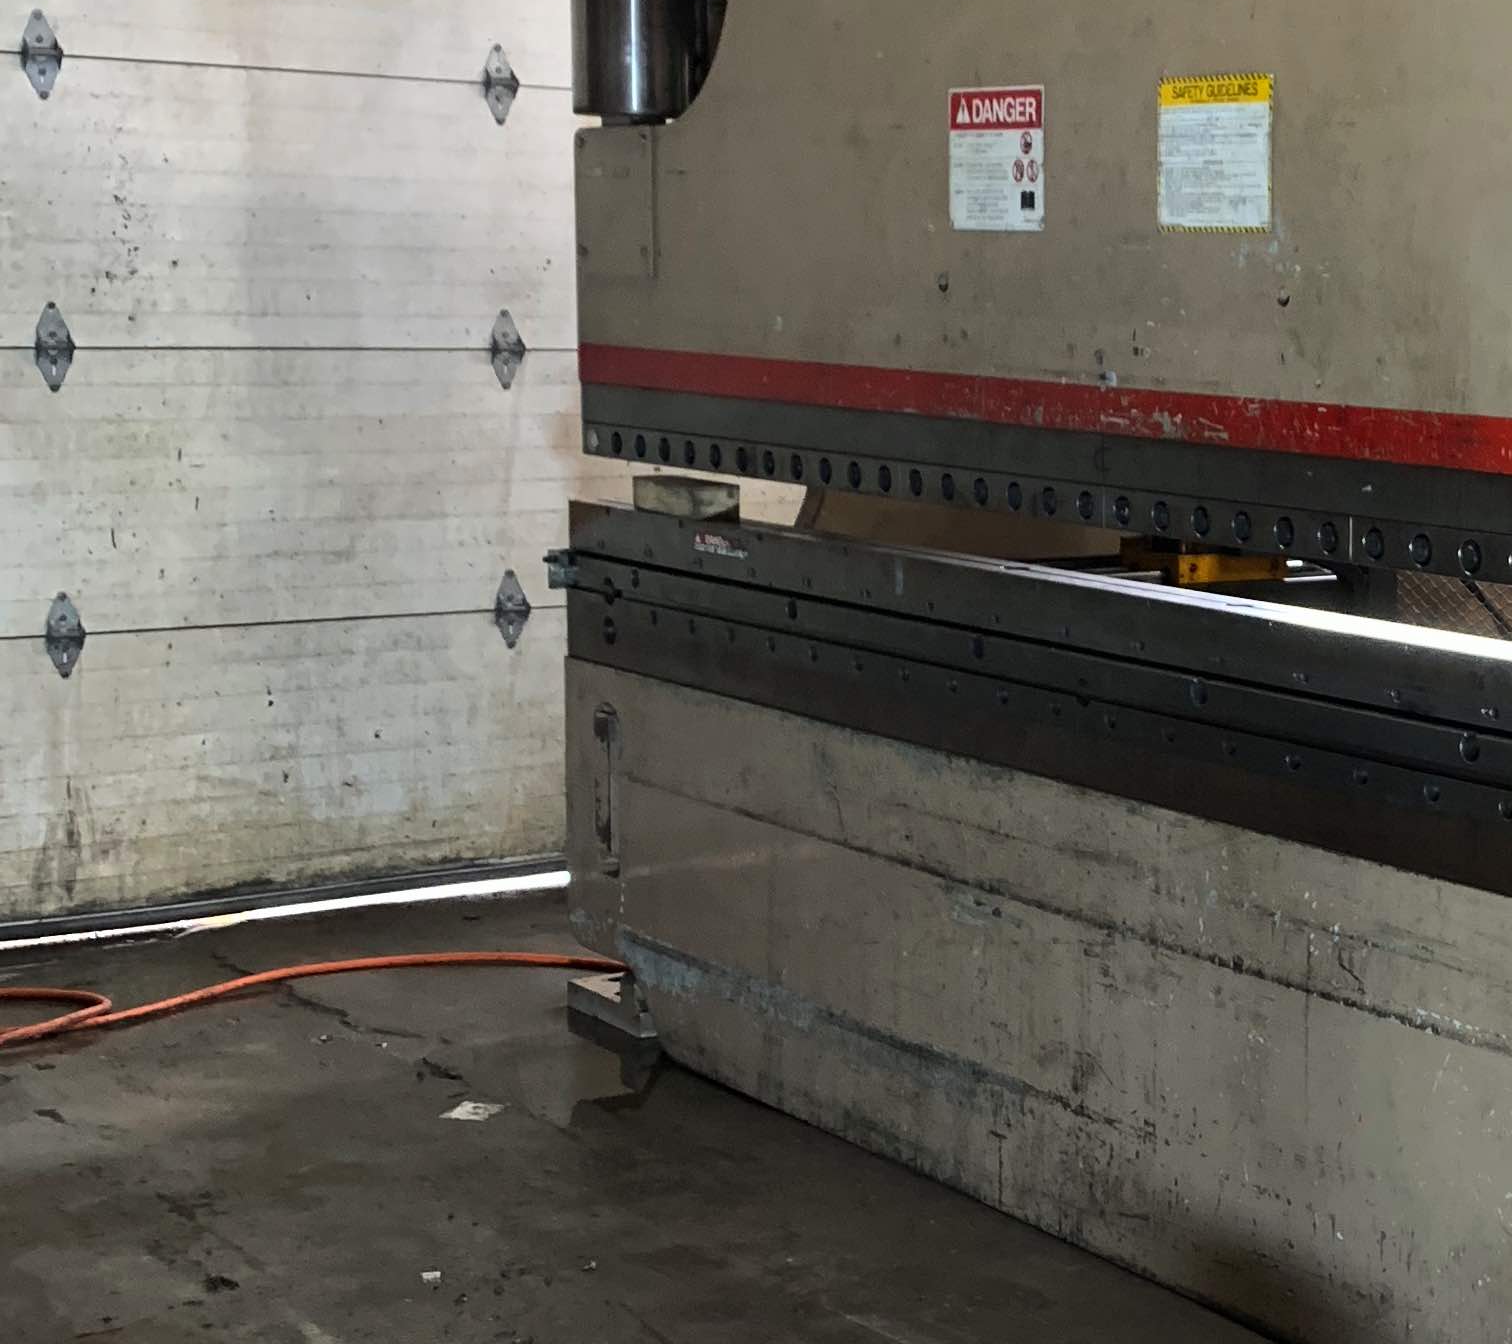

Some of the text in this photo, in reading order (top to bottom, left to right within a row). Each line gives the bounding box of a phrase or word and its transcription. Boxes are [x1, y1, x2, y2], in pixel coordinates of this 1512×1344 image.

[1172, 82, 1258, 99] SAFETY GUIDELINES
[972, 97, 1036, 123] DANGER
